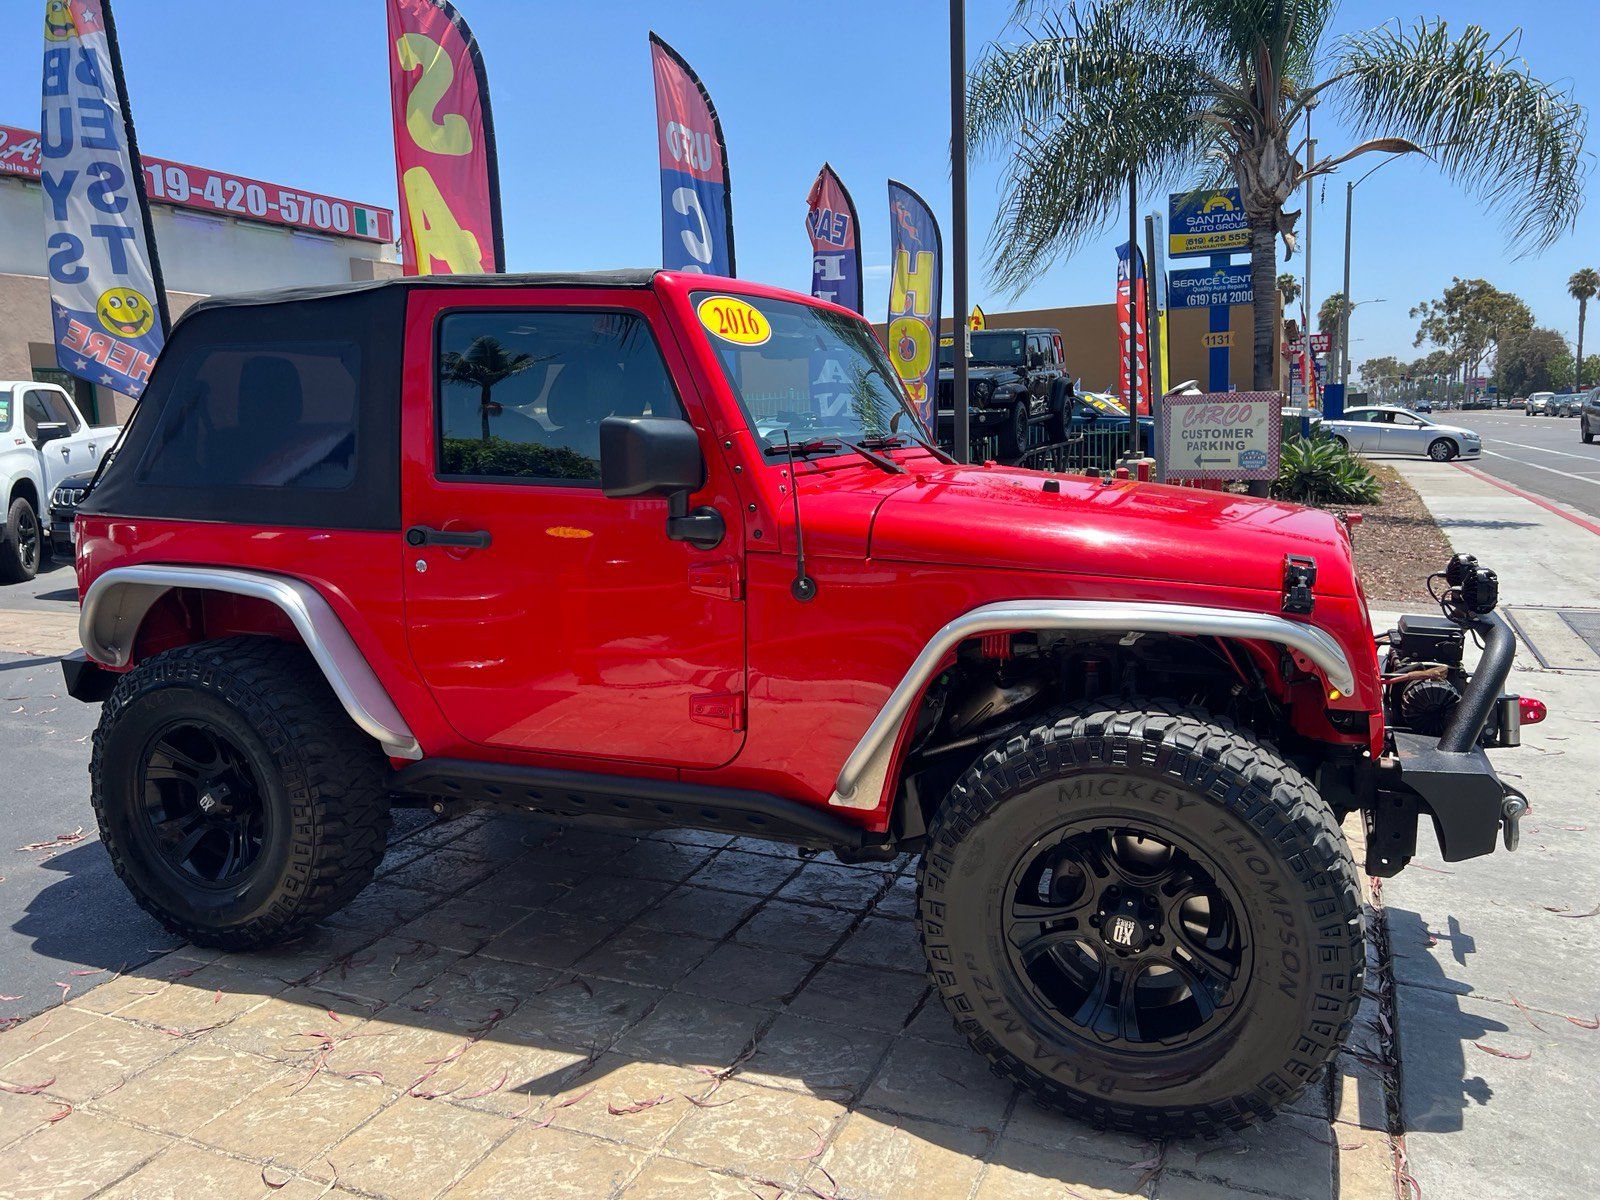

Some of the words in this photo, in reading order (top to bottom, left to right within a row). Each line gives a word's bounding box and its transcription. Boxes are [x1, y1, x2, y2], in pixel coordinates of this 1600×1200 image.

[143, 163, 350, 233] 19-420-5700
[1186, 212, 1248, 226] SANTANA
[1189, 224, 1214, 233] AUTO
[1215, 221, 1248, 231] GROUP
[1172, 277, 1220, 288] SERVICE
[1186, 293, 1210, 306] (619)
[1211, 292, 1228, 304] 614
[1229, 290, 1254, 303] 2000
[714, 306, 760, 335] 2016
[1204, 334, 1230, 345] 1131
[1182, 404, 1253, 428] CARCO
[1181, 428, 1254, 439] CUSTOMER
[1186, 440, 1246, 451] PARKING
[1057, 778, 1201, 812] MICKEY
[1213, 820, 1303, 1000] THOMPSON
[1113, 924, 1134, 946] XD
